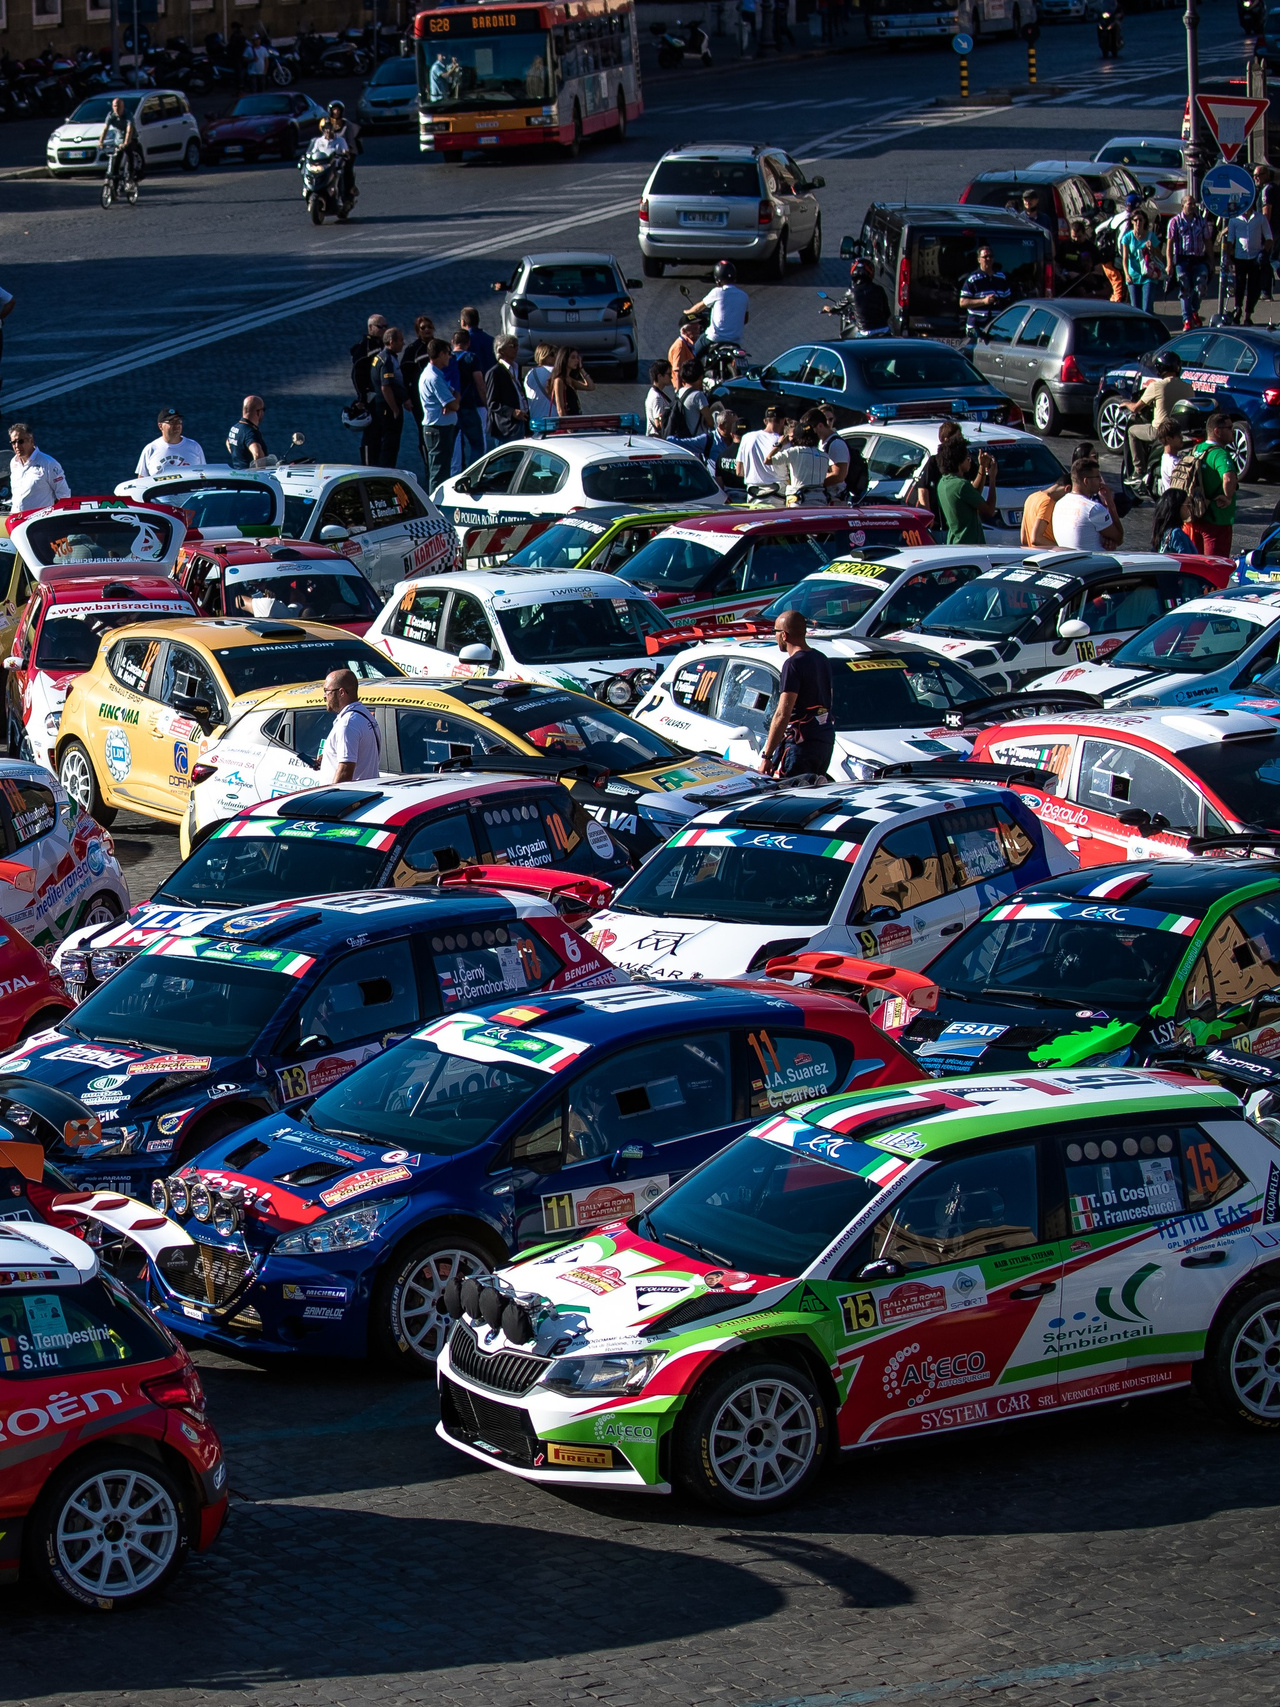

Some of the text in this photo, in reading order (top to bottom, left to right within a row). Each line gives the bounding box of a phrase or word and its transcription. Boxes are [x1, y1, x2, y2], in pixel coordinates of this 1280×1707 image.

[429, 18, 450, 32] 628
[413, 533, 447, 567] KARTING
[550, 586, 592, 597] TWINGO
[58, 601, 184, 615] www.barisracing.it
[252, 641, 334, 652] RENAULT SPORT
[1076, 641, 1095, 661] 113
[1040, 796, 1089, 826] iperauto
[546, 813, 570, 850] 10
[506, 839, 547, 859] N.Gryazin
[35, 860, 89, 920] mediterranea
[863, 934, 877, 957] 9
[584, 959, 622, 983] BENZINA
[945, 1022, 1006, 1037] ESAF
[747, 1029, 782, 1076] 11
[281, 1065, 307, 1099] 13
[763, 1060, 829, 1090] J.A. Suarez
[768, 1083, 828, 1109] C. Carrera
[293, 1129, 377, 1159] PEUGEOT SPORT
[1186, 1143, 1218, 1196] 15
[579, 1197, 632, 1214] RALLY ROMA
[1107, 1183, 1171, 1207] Di Cosimo
[1266, 1168, 1280, 1224] ACQUAFLEX
[546, 1193, 573, 1230] 11
[1104, 1200, 1177, 1227] Francescucci
[1152, 1211, 1209, 1242] TUTTO
[1213, 1202, 1254, 1227] GAS
[1167, 1240, 1183, 1250] GPL
[1192, 1238, 1235, 1253] Simone Aiello
[993, 1259, 1008, 1270] HAIR
[1008, 1254, 1031, 1266] STYLING
[1031, 1249, 1055, 1261] STEFANO
[306, 1288, 347, 1299] MICHELIN
[636, 1285, 684, 1294] ACQUAFLEX
[883, 1290, 943, 1312] RALLY ROMA
[841, 1294, 876, 1331] 15
[895, 1302, 933, 1315] CAPITALE
[950, 1297, 984, 1311] SPORT
[17, 1323, 111, 1352] S.Tempestini
[1043, 1321, 1109, 1343] Servizi
[1043, 1323, 1155, 1356] Ambientali
[22, 1351, 60, 1371] S.Itu
[901, 1351, 987, 1388] ALECO
[937, 1371, 991, 1389] AUTOSPURGHI
[920, 1371, 1173, 1431] SYSTEM CAR SRL VERNICIATURE INDUSTRIALI
[605, 1423, 654, 1439] ALECO
[554, 1447, 606, 1466] PIRELLI
